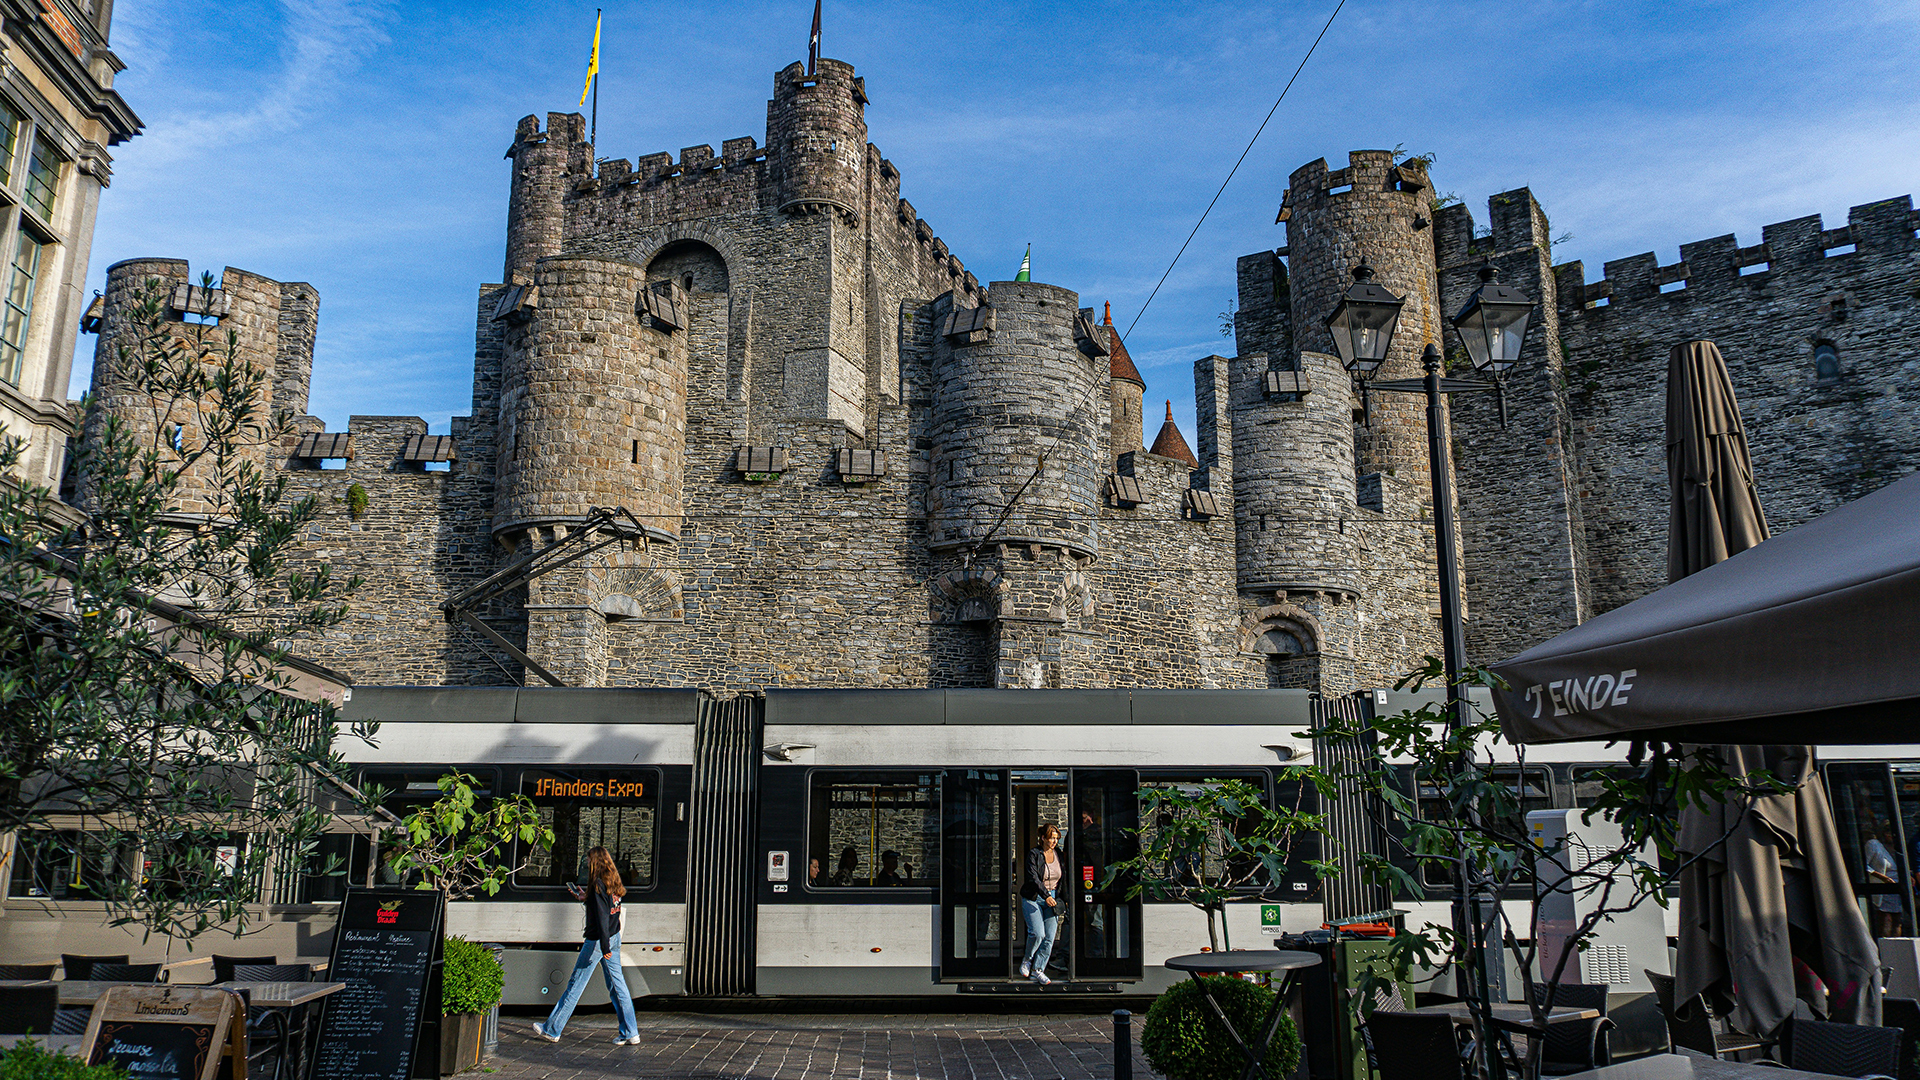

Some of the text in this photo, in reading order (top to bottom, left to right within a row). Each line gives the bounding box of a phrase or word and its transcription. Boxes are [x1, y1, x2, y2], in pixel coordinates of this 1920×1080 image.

[1548, 669, 1637, 716] EINDE
[608, 779, 643, 797] Expo
[345, 930, 380, 941] Restaurant
